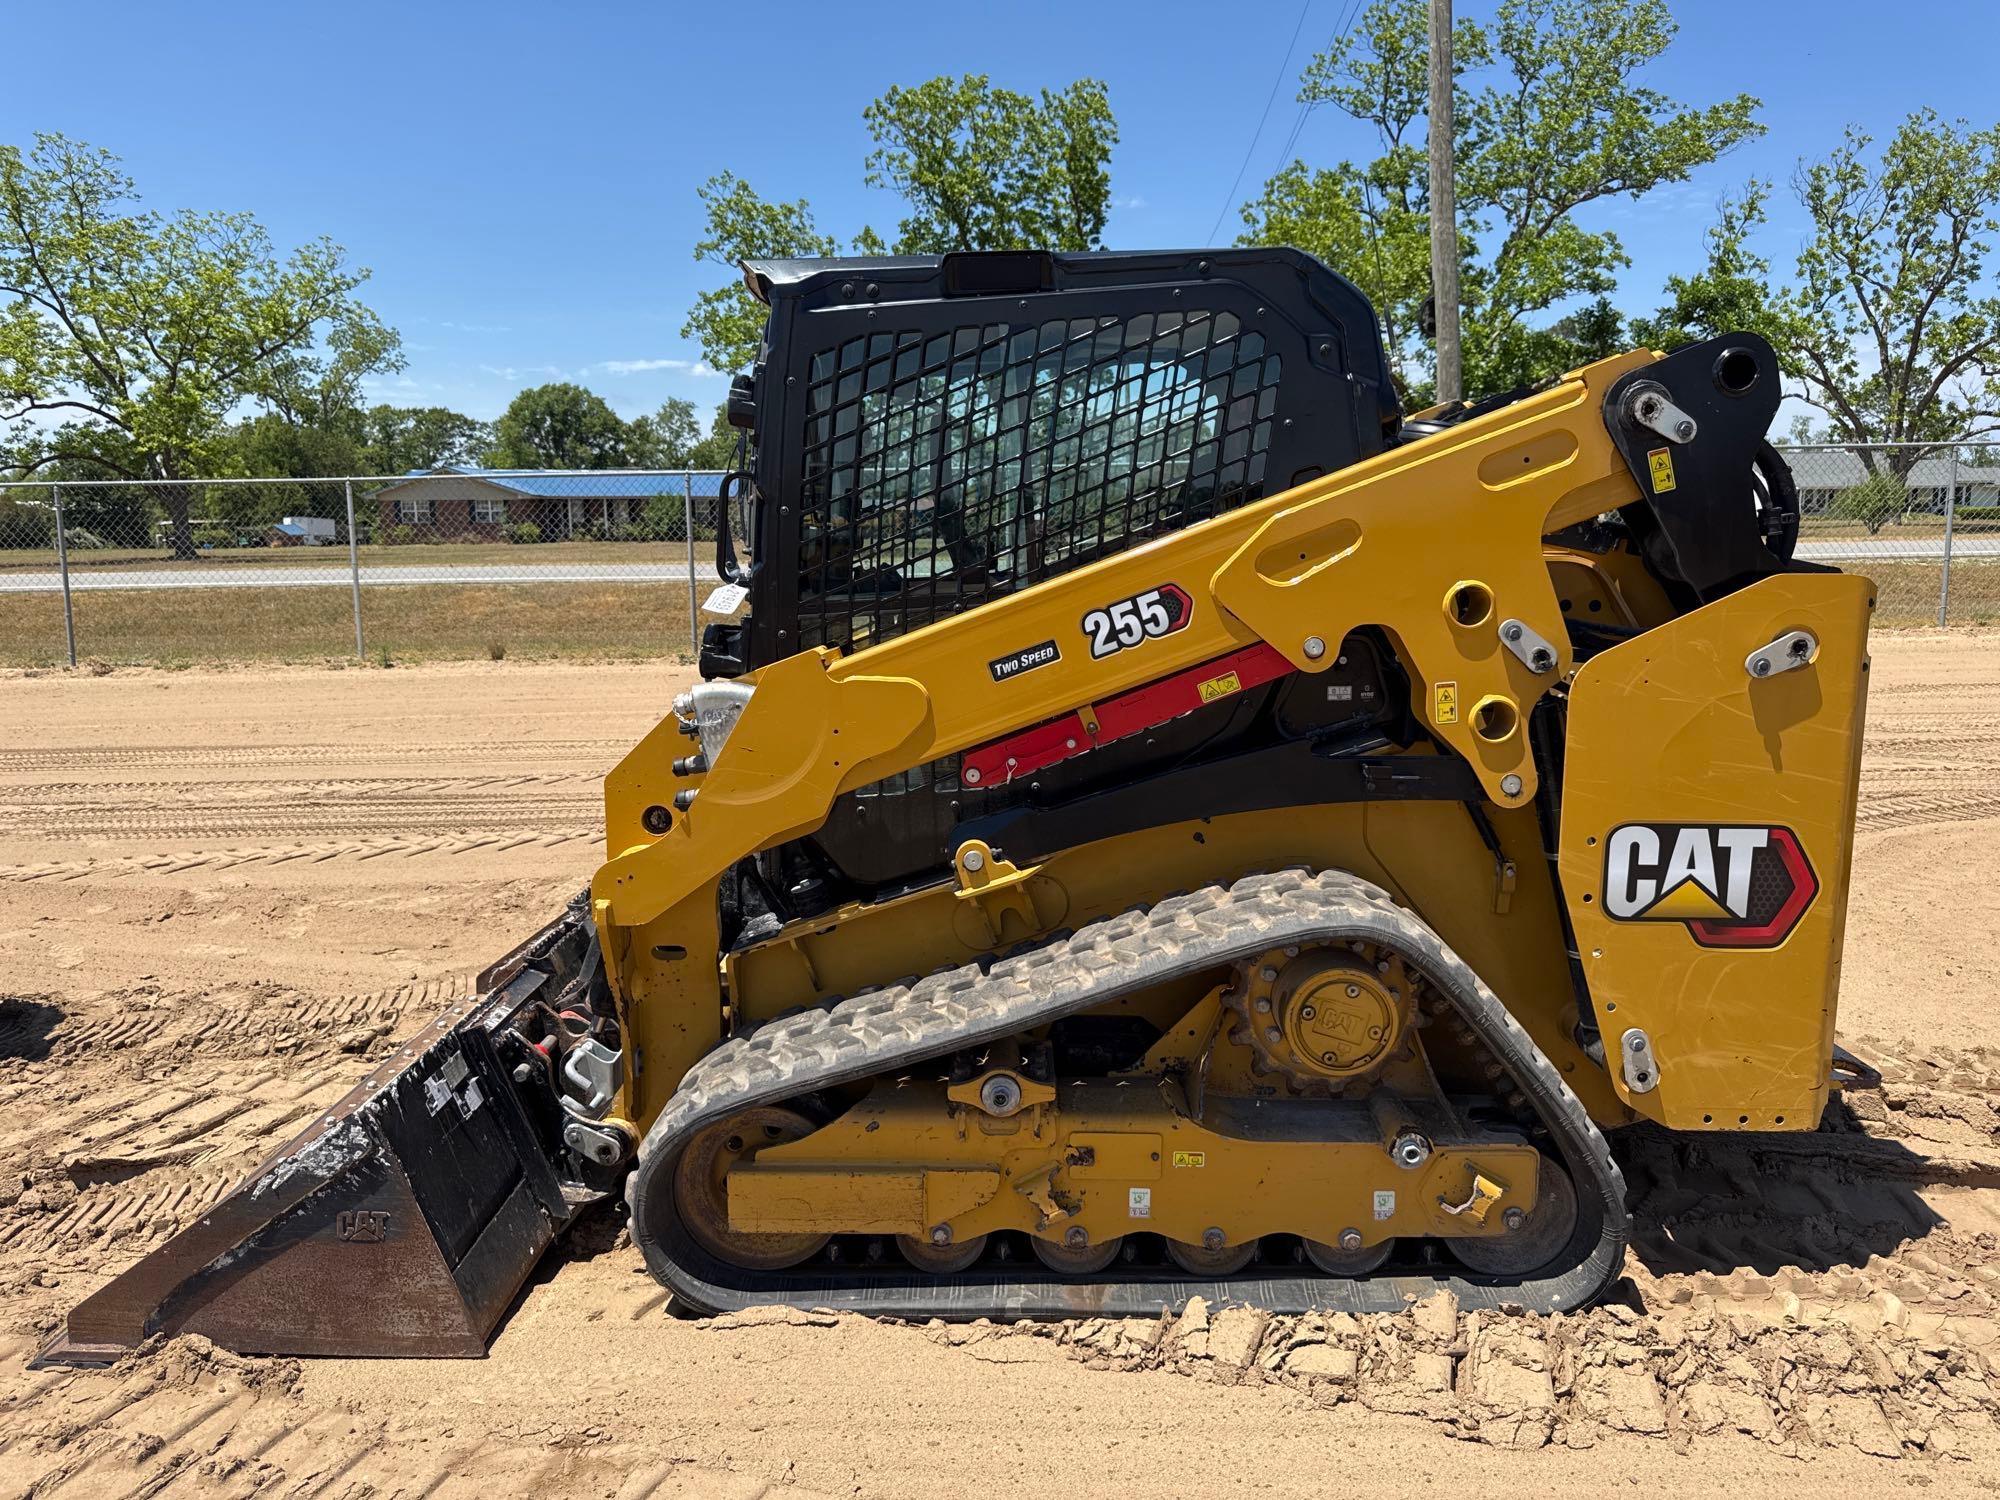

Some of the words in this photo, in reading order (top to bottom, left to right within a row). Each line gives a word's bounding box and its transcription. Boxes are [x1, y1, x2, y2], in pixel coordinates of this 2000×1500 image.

[1084, 591, 1170, 657] 255
[1606, 825, 1768, 918] CAT
[1321, 1007, 1364, 1035] CAT
[336, 1211, 391, 1242] CAT
